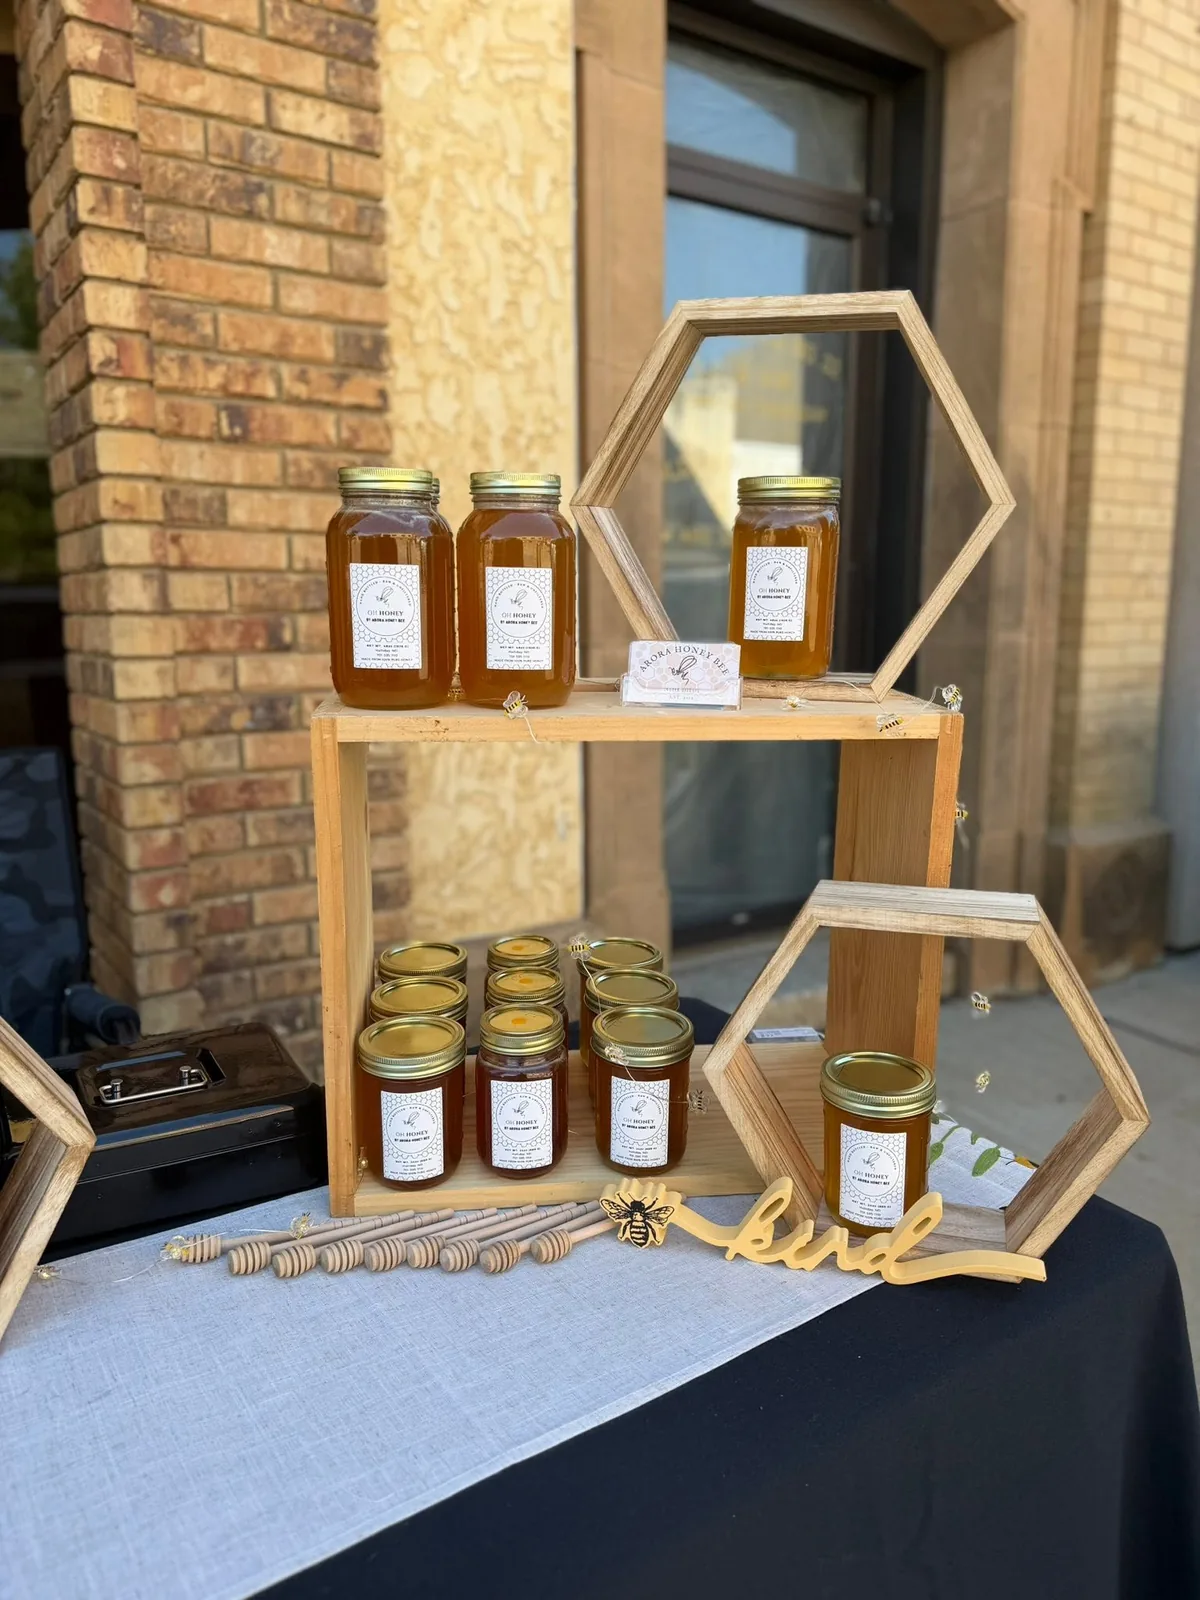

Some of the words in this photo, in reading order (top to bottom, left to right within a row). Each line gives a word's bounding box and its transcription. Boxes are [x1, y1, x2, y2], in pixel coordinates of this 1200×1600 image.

[640, 648, 671, 672] ARORA
[675, 646, 713, 659] HONEY
[713, 658, 730, 676] BEE
[703, 1176, 1047, 1285] kind
